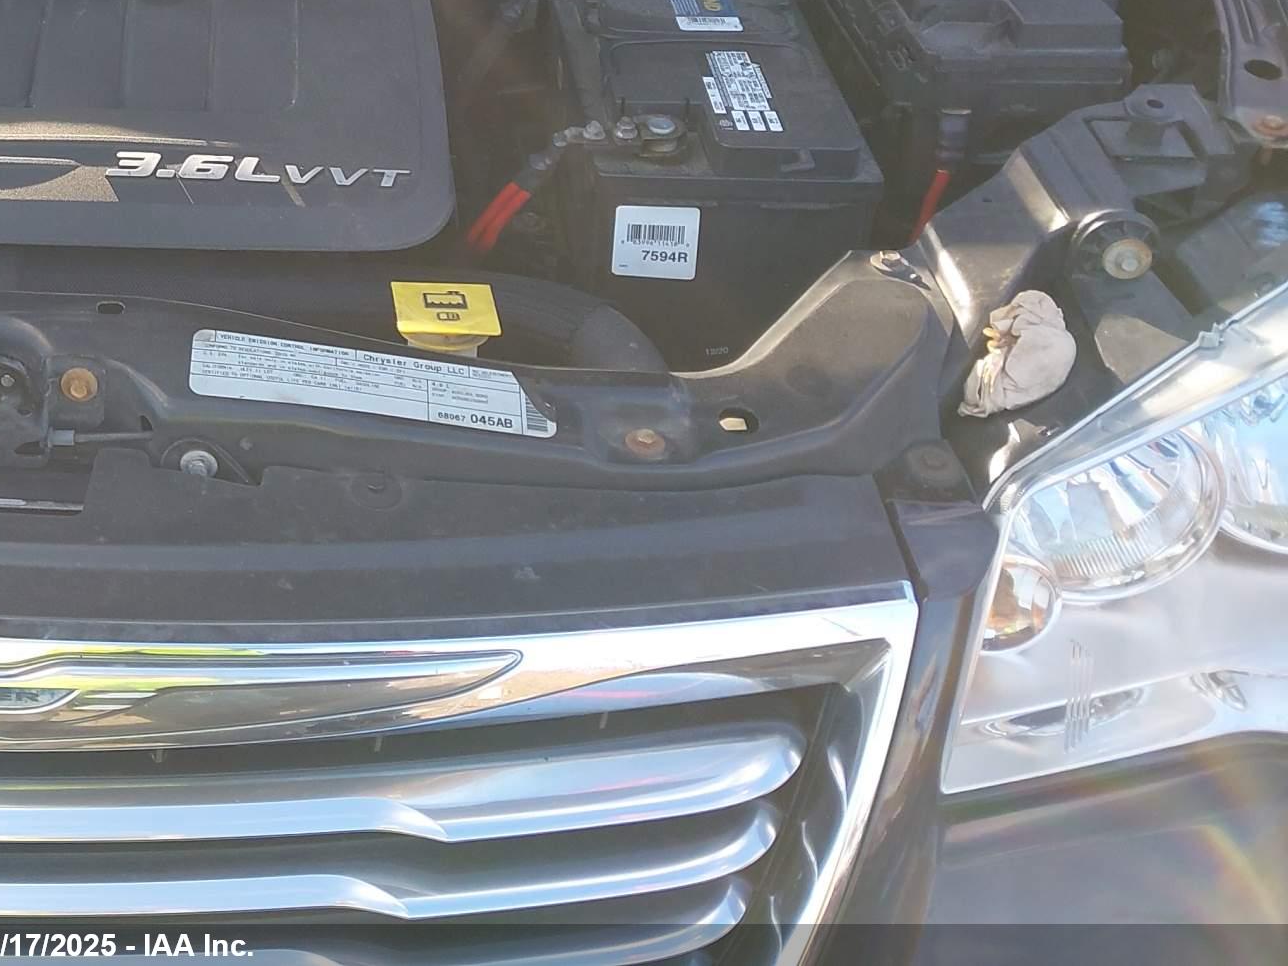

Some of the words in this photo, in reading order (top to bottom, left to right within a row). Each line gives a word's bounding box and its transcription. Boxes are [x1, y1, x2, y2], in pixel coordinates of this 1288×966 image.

[105, 151, 281, 183] 3.6L
[285, 164, 411, 187] VVT
[641, 249, 689, 263] 7594R
[363, 353, 407, 367] Chrysler
[413, 361, 442, 372] Group
[447, 364, 465, 375] LLC
[470, 413, 513, 429] 045AB
